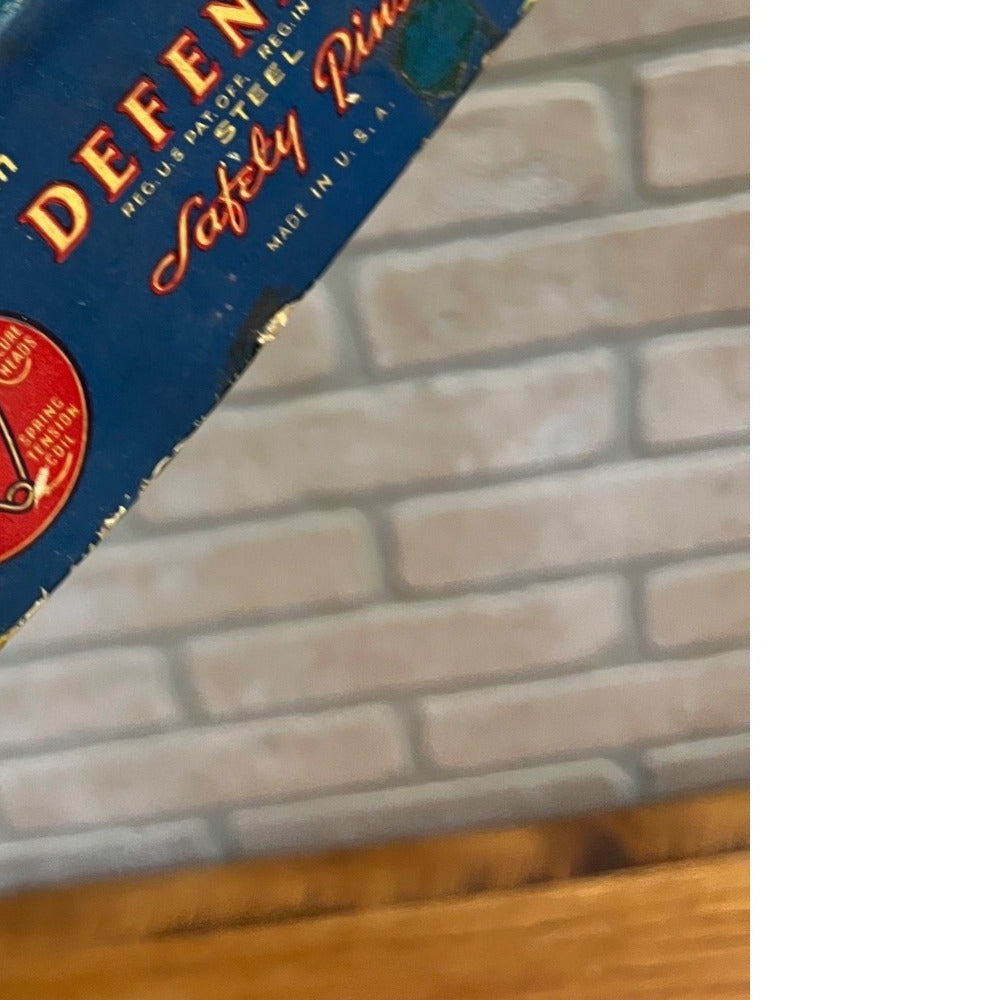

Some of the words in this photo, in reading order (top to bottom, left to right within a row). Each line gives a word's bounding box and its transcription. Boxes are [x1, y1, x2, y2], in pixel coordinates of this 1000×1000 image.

[291, 0, 311, 21] IN
[213, 49, 304, 144] STEEL
[150, 109, 309, 295] Safety
[266, 203, 309, 252] MADE
[310, 172, 334, 200] IN
[0, 335, 38, 378] HEADS
[18, 395, 66, 447] SPRING
[27, 403, 80, 462] TENSION
[45, 435, 77, 467] COIL
